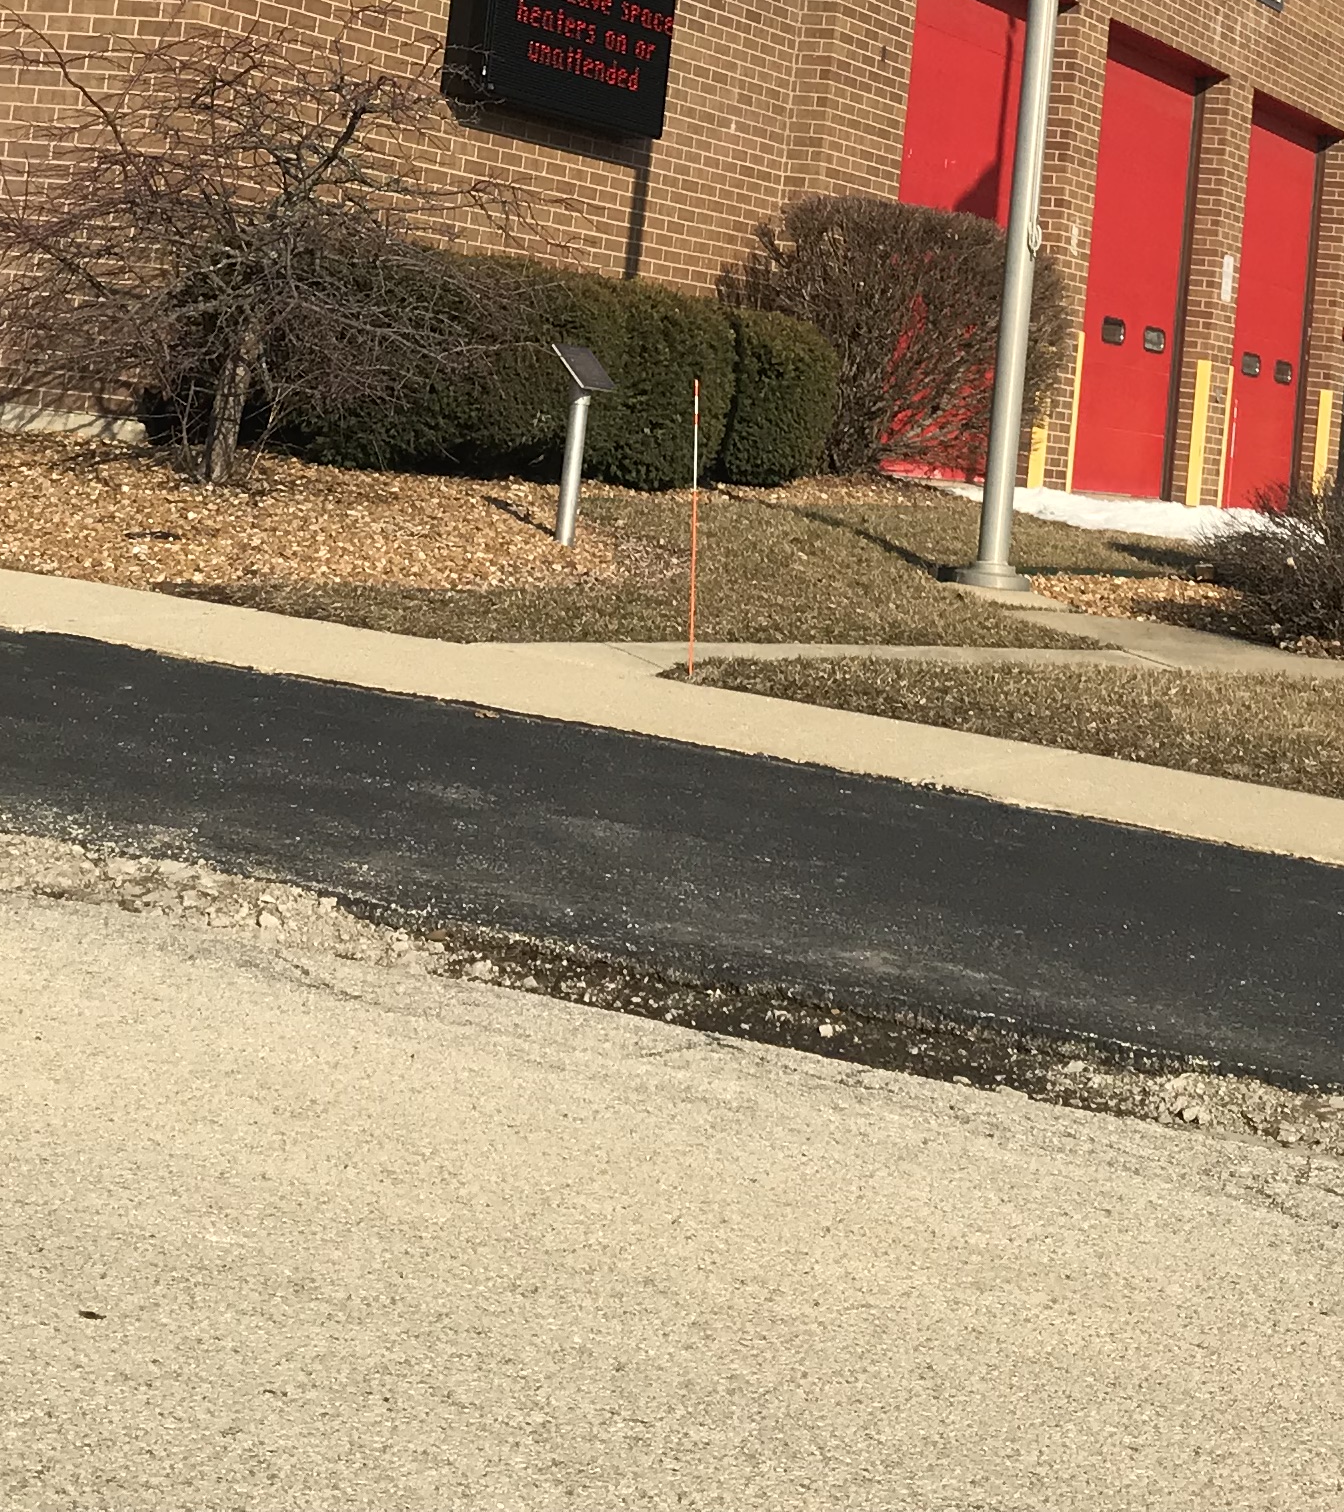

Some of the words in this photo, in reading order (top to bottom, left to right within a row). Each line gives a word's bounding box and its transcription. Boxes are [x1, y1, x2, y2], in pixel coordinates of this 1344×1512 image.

[620, 0, 674, 36] space
[605, 30, 629, 55] on
[634, 40, 657, 62] or
[527, 40, 641, 92] unattended
